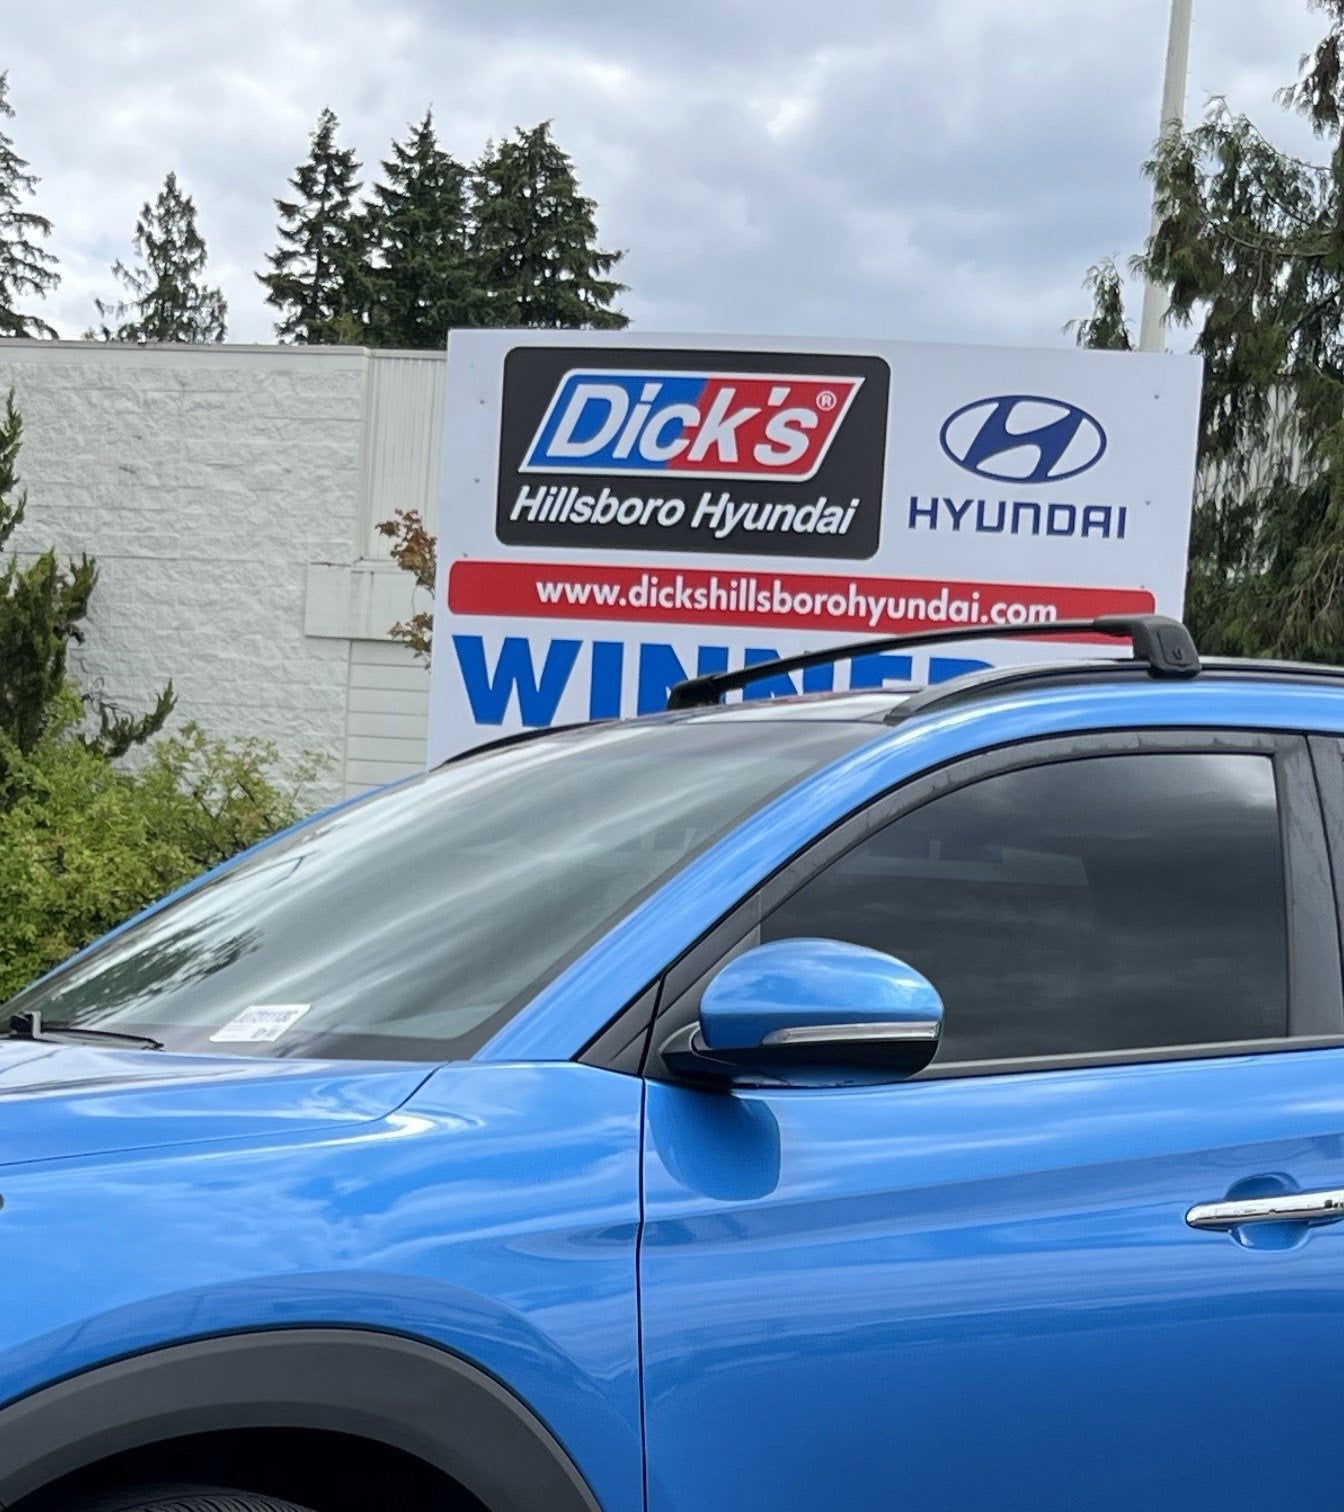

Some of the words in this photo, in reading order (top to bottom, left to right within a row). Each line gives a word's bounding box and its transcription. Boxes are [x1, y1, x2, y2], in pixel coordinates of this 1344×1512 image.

[546, 380, 819, 467] Dick's
[510, 486, 685, 531] Hillsboro
[691, 494, 859, 539] Hyundai
[908, 496, 1126, 539] HYUNDAI
[536, 578, 1057, 627] www.dickshillsborohyundai.com
